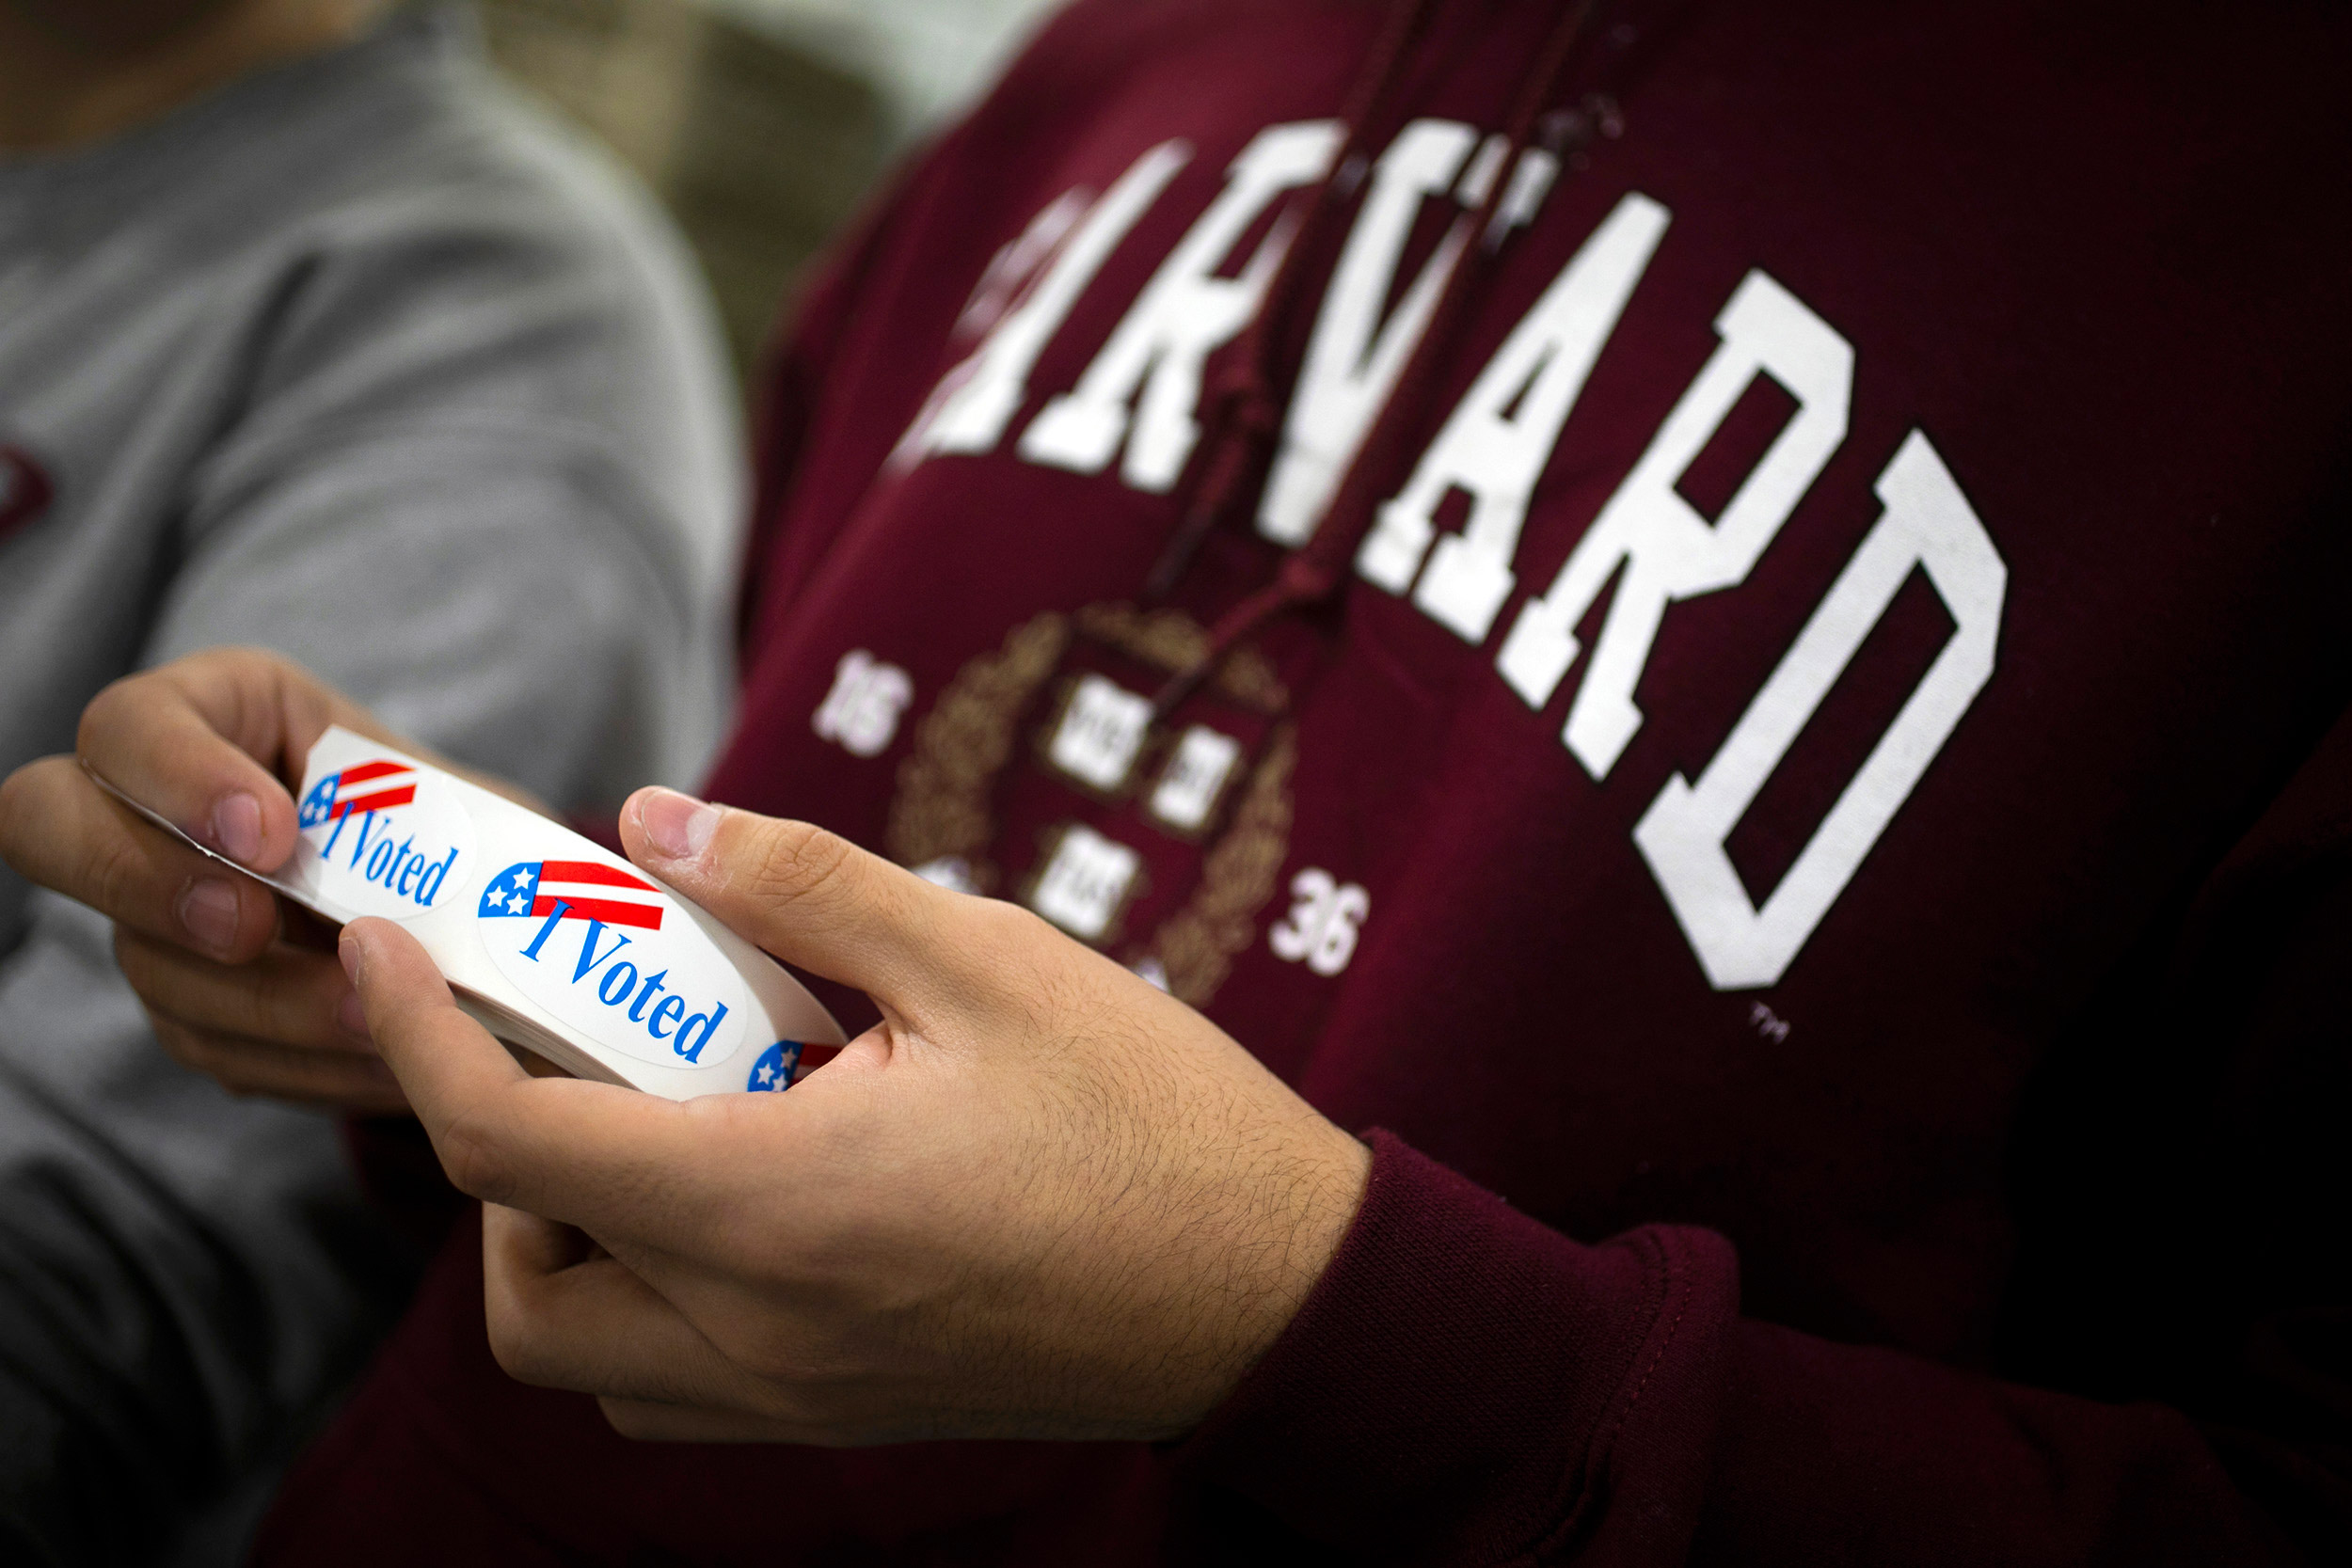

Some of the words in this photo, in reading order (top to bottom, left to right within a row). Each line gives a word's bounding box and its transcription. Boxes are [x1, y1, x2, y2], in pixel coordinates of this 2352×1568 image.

[882, 117, 2009, 990] RVARD
[320, 800, 355, 861] I
[348, 808, 459, 907] Voted
[1267, 865, 1372, 978] 36
[518, 897, 576, 963] I
[571, 916, 729, 1065] Voted
